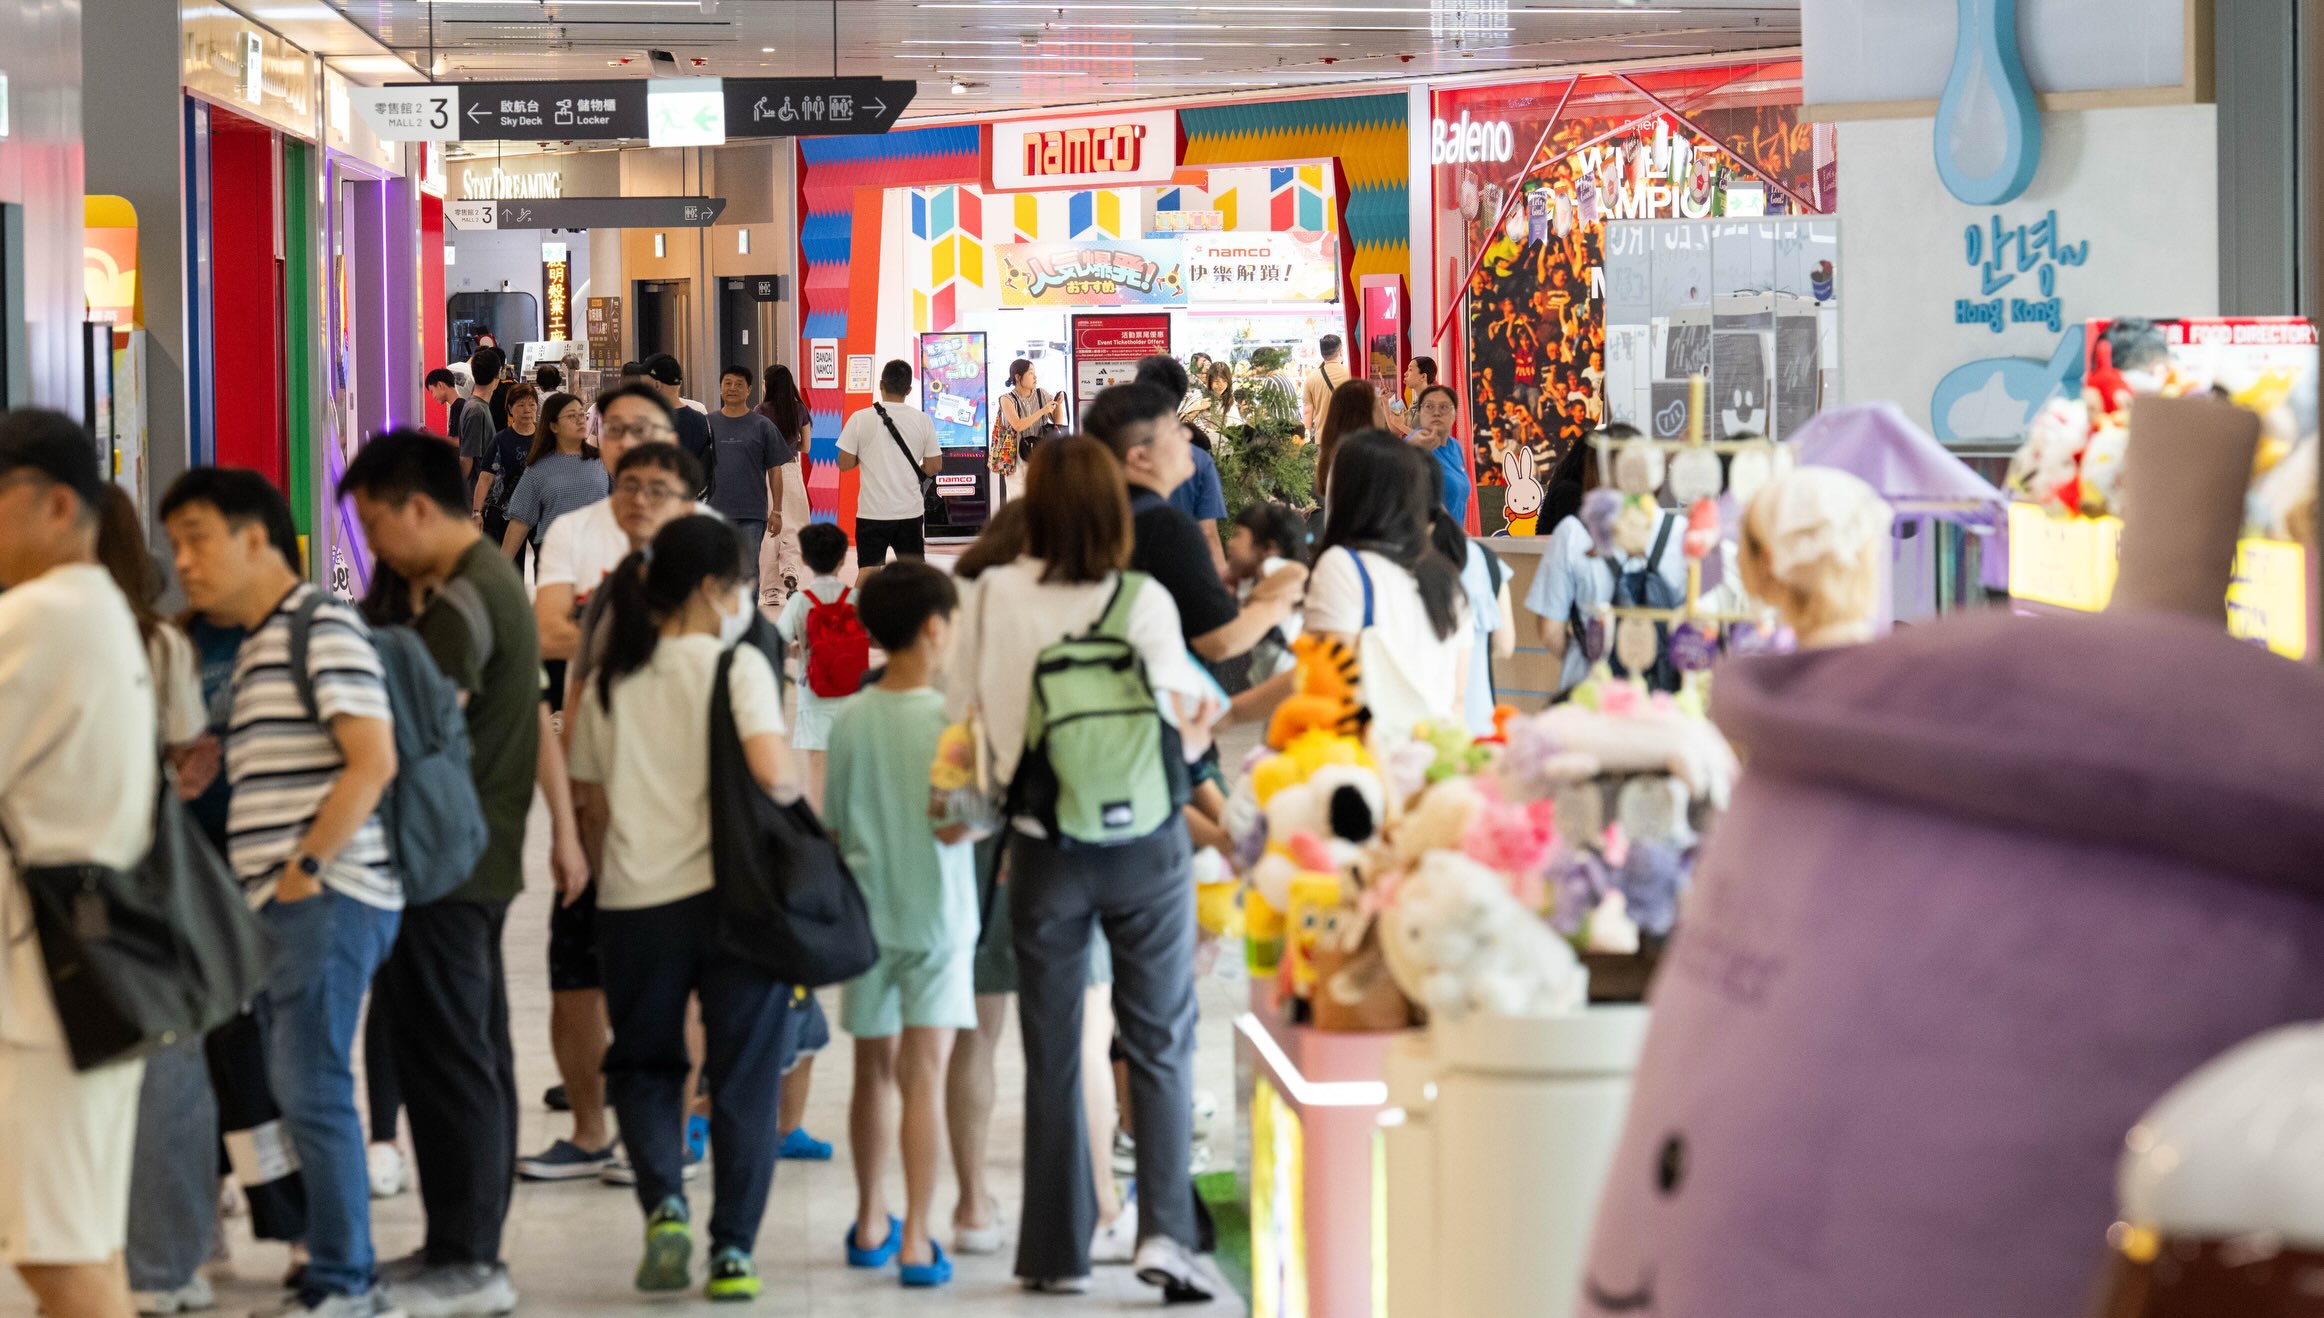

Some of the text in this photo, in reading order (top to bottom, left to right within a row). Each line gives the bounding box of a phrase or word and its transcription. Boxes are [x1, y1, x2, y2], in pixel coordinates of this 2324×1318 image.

[374, 102, 423, 115] 零售館 2
[500, 99, 540, 113] 啟航台
[577, 98, 616, 113] 儲物櫃
[429, 98, 449, 130] 3
[500, 116, 543, 127] Sky Deck
[576, 115, 610, 125] Locker
[388, 117, 423, 127] MALL 2
[1432, 110, 1513, 164] Baleno
[1023, 124, 1140, 176] namco
[1577, 146, 1717, 179] WEE
[463, 167, 561, 199] STAY DREAMING
[482, 207, 492, 224] 3
[1208, 248, 1271, 257] namco
[1066, 280, 1117, 295] おすすめ
[1955, 297, 2062, 333] Hong Kong
[2189, 324, 2232, 344] FOOD
[2233, 324, 2320, 344] DIRECTORY
[816, 352, 832, 363] BANDAI
[816, 364, 832, 375] NAMCO
